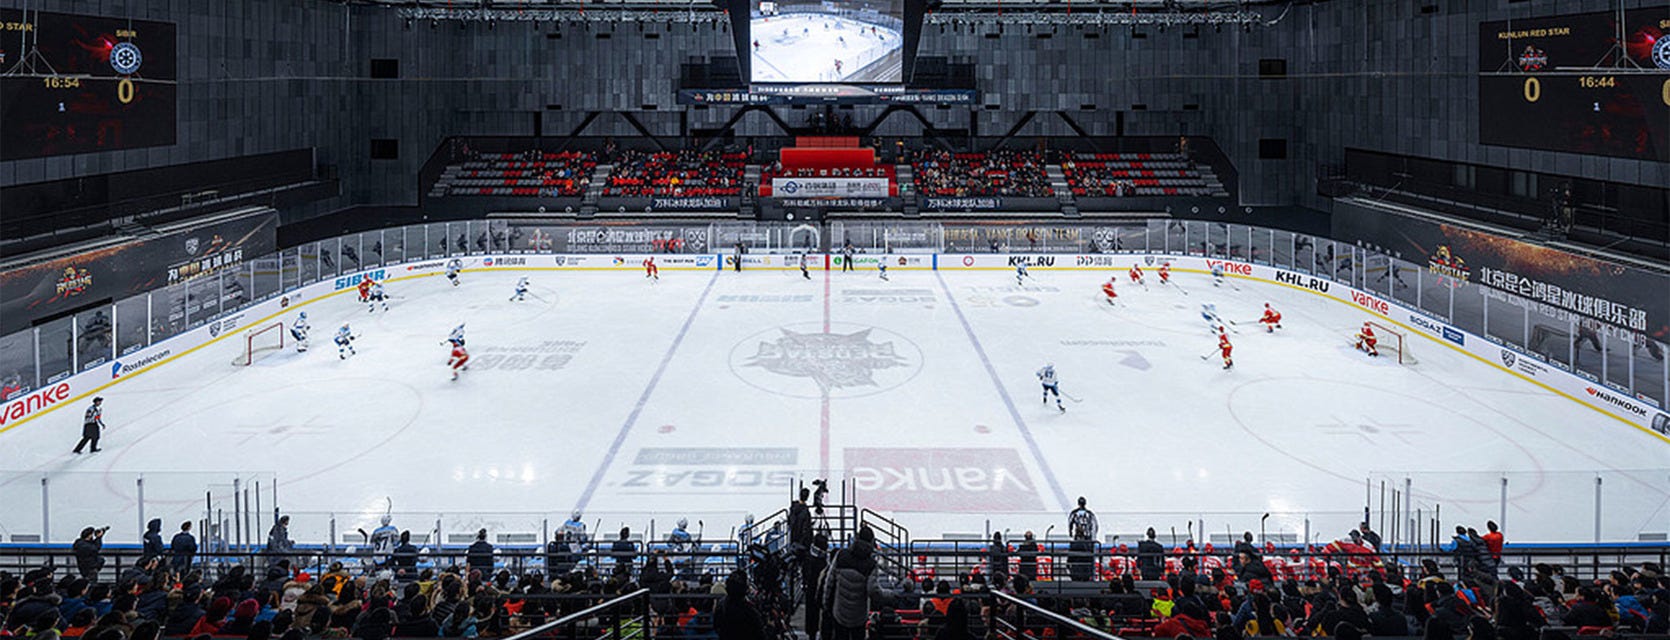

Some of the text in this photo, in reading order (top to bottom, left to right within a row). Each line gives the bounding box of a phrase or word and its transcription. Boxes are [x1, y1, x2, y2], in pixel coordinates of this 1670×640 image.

[6, 22, 33, 32] STAR
[116, 29, 137, 39] SIBR
[1498, 27, 1570, 40] KUNLUN RED STAR
[43, 78, 80, 89] 16:54
[1524, 77, 1541, 103] 0
[1578, 76, 1616, 88] 16:44
[117, 79, 135, 103] 0
[58, 102, 66, 112] 1
[1593, 102, 1600, 112] 1
[1008, 256, 1055, 266] KHL.RU
[1275, 270, 1329, 292] KHL.RU
[1350, 289, 1389, 315] vanke
[1479, 266, 1647, 331] 北京昆仑鸿星冰球俱乐部
[1409, 315, 1442, 334] SOGAZ
[122, 349, 170, 374] Rostelecom
[621, 470, 797, 487] SOGAZ
[853, 466, 1034, 493] vanke
